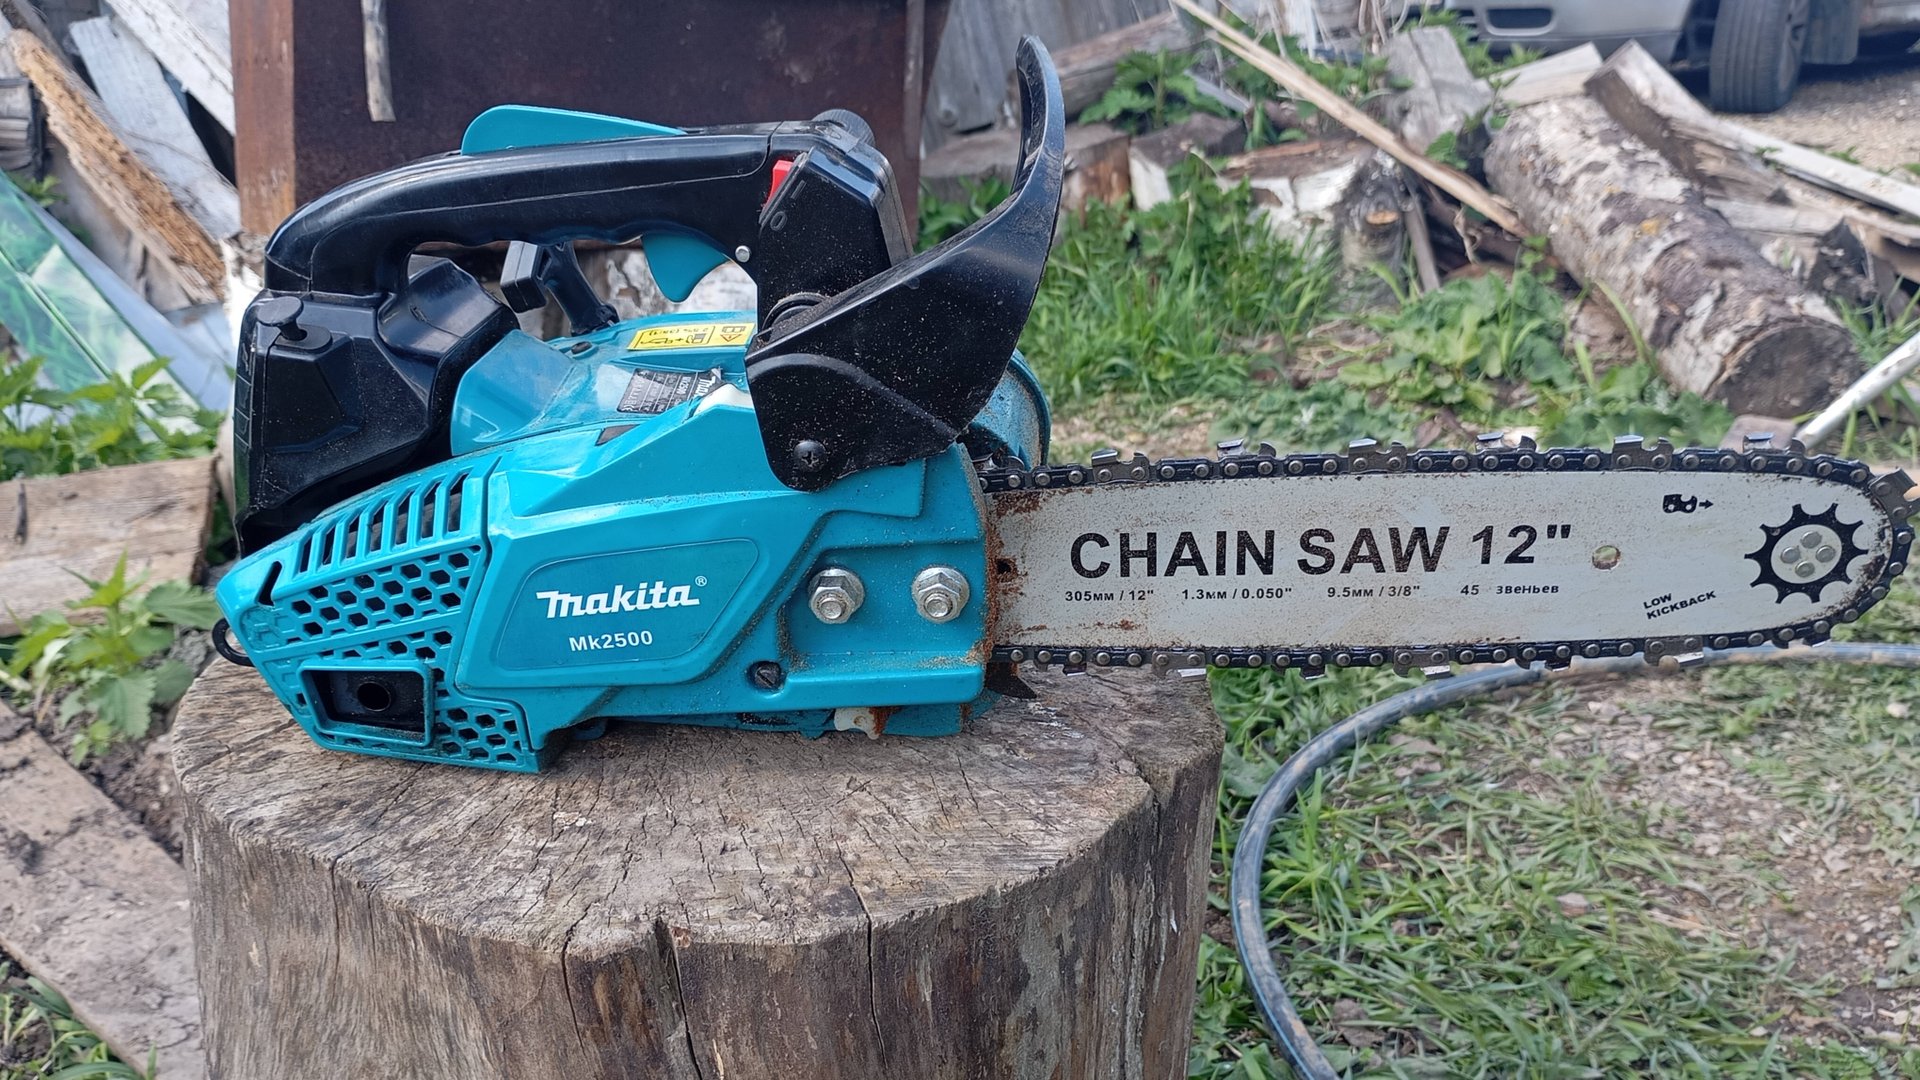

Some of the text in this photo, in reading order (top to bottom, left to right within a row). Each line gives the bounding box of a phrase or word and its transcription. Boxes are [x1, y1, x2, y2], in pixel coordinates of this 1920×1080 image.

[1070, 524, 1571, 578] CHAIN SAW 12"
[1128, 590, 1154, 601] 12"
[1242, 588, 1292, 599] 0.050"
[1388, 586, 1420, 596] 3/8"
[1461, 585, 1479, 595] 45
[1643, 593, 1672, 609] LOW
[1647, 591, 1716, 619] KICKBACK
[569, 630, 653, 651] Mk2500
